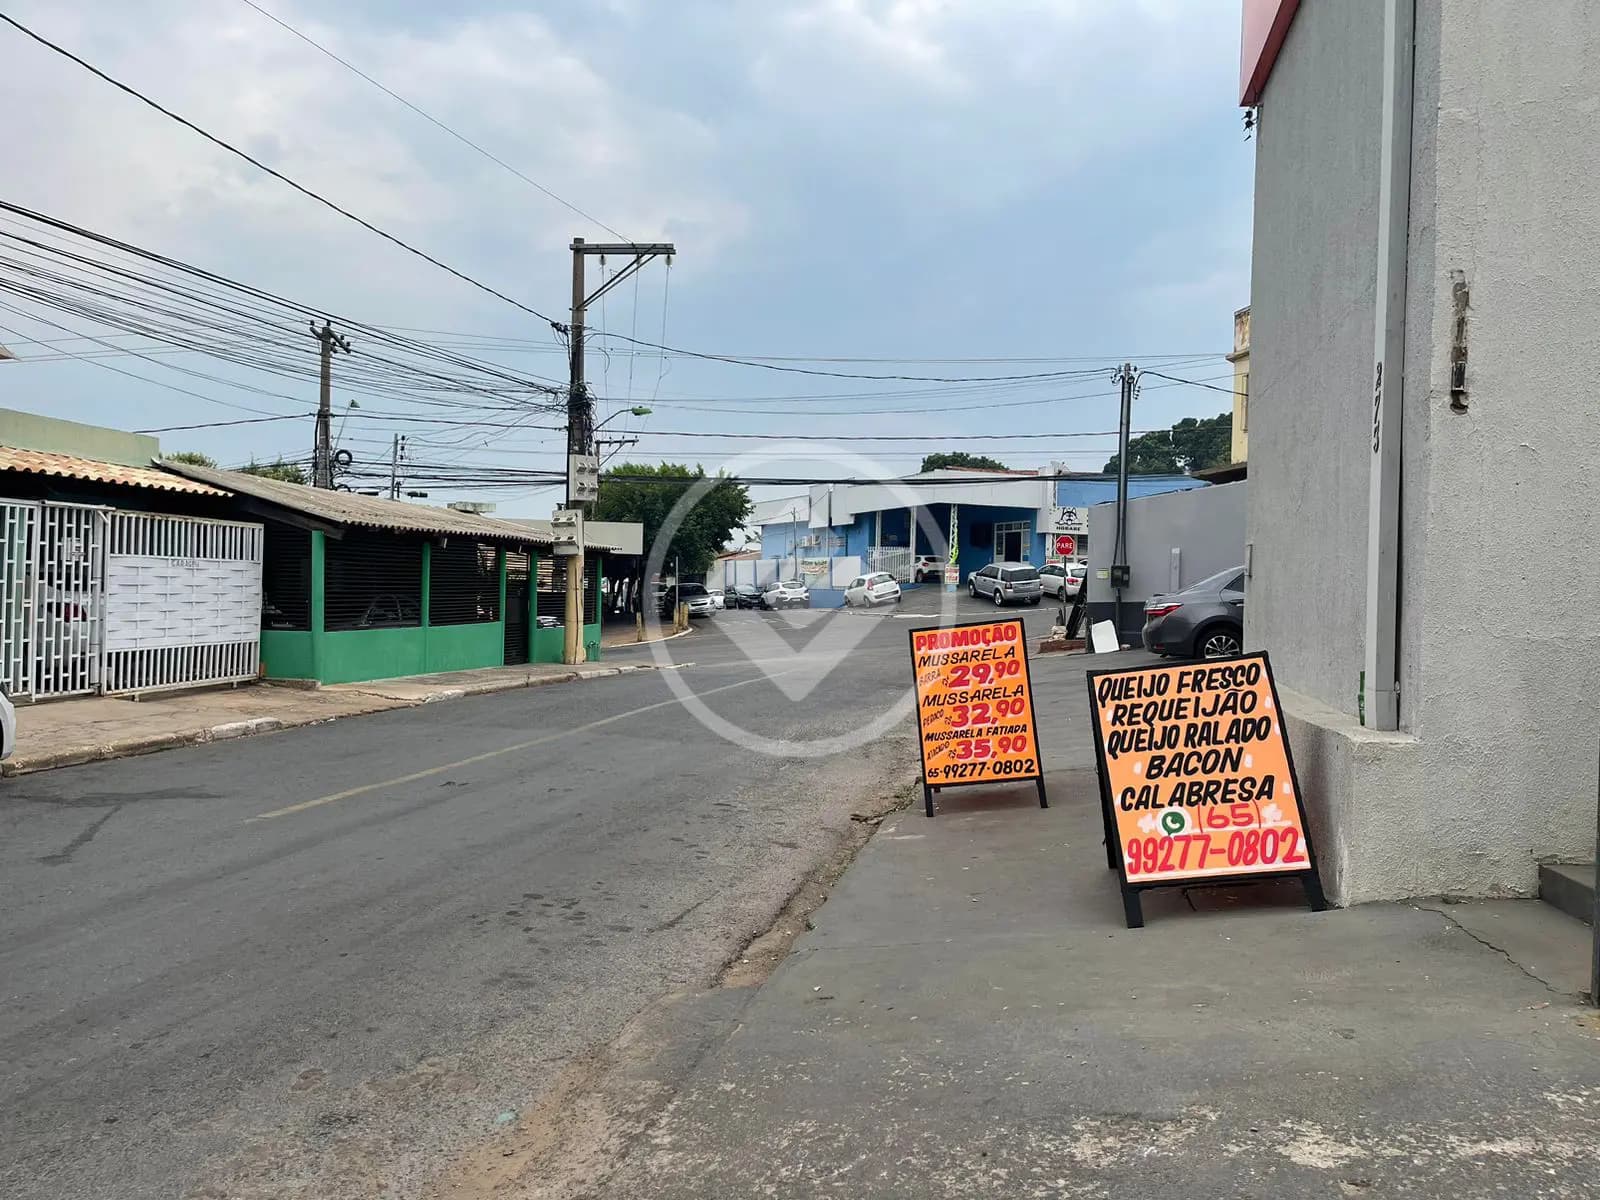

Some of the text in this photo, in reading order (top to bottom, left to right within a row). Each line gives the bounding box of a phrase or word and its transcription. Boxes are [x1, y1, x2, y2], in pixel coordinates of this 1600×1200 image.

[916, 624, 1017, 651] PROMOÇÃO
[918, 645, 1016, 669] MUSSARELA
[922, 684, 1024, 708] MUSSARELA
[1097, 662, 1261, 708] QUEIJO FRESCO
[1111, 687, 1257, 728] REQUEIJÃO
[924, 723, 1028, 743] MUSSARELA FATIADA
[1107, 715, 1272, 759] QUEIJO RALADO
[1145, 747, 1244, 780] BACON
[1120, 775, 1275, 812] CALABRESA
[1127, 828, 1305, 874] 99277-0802
